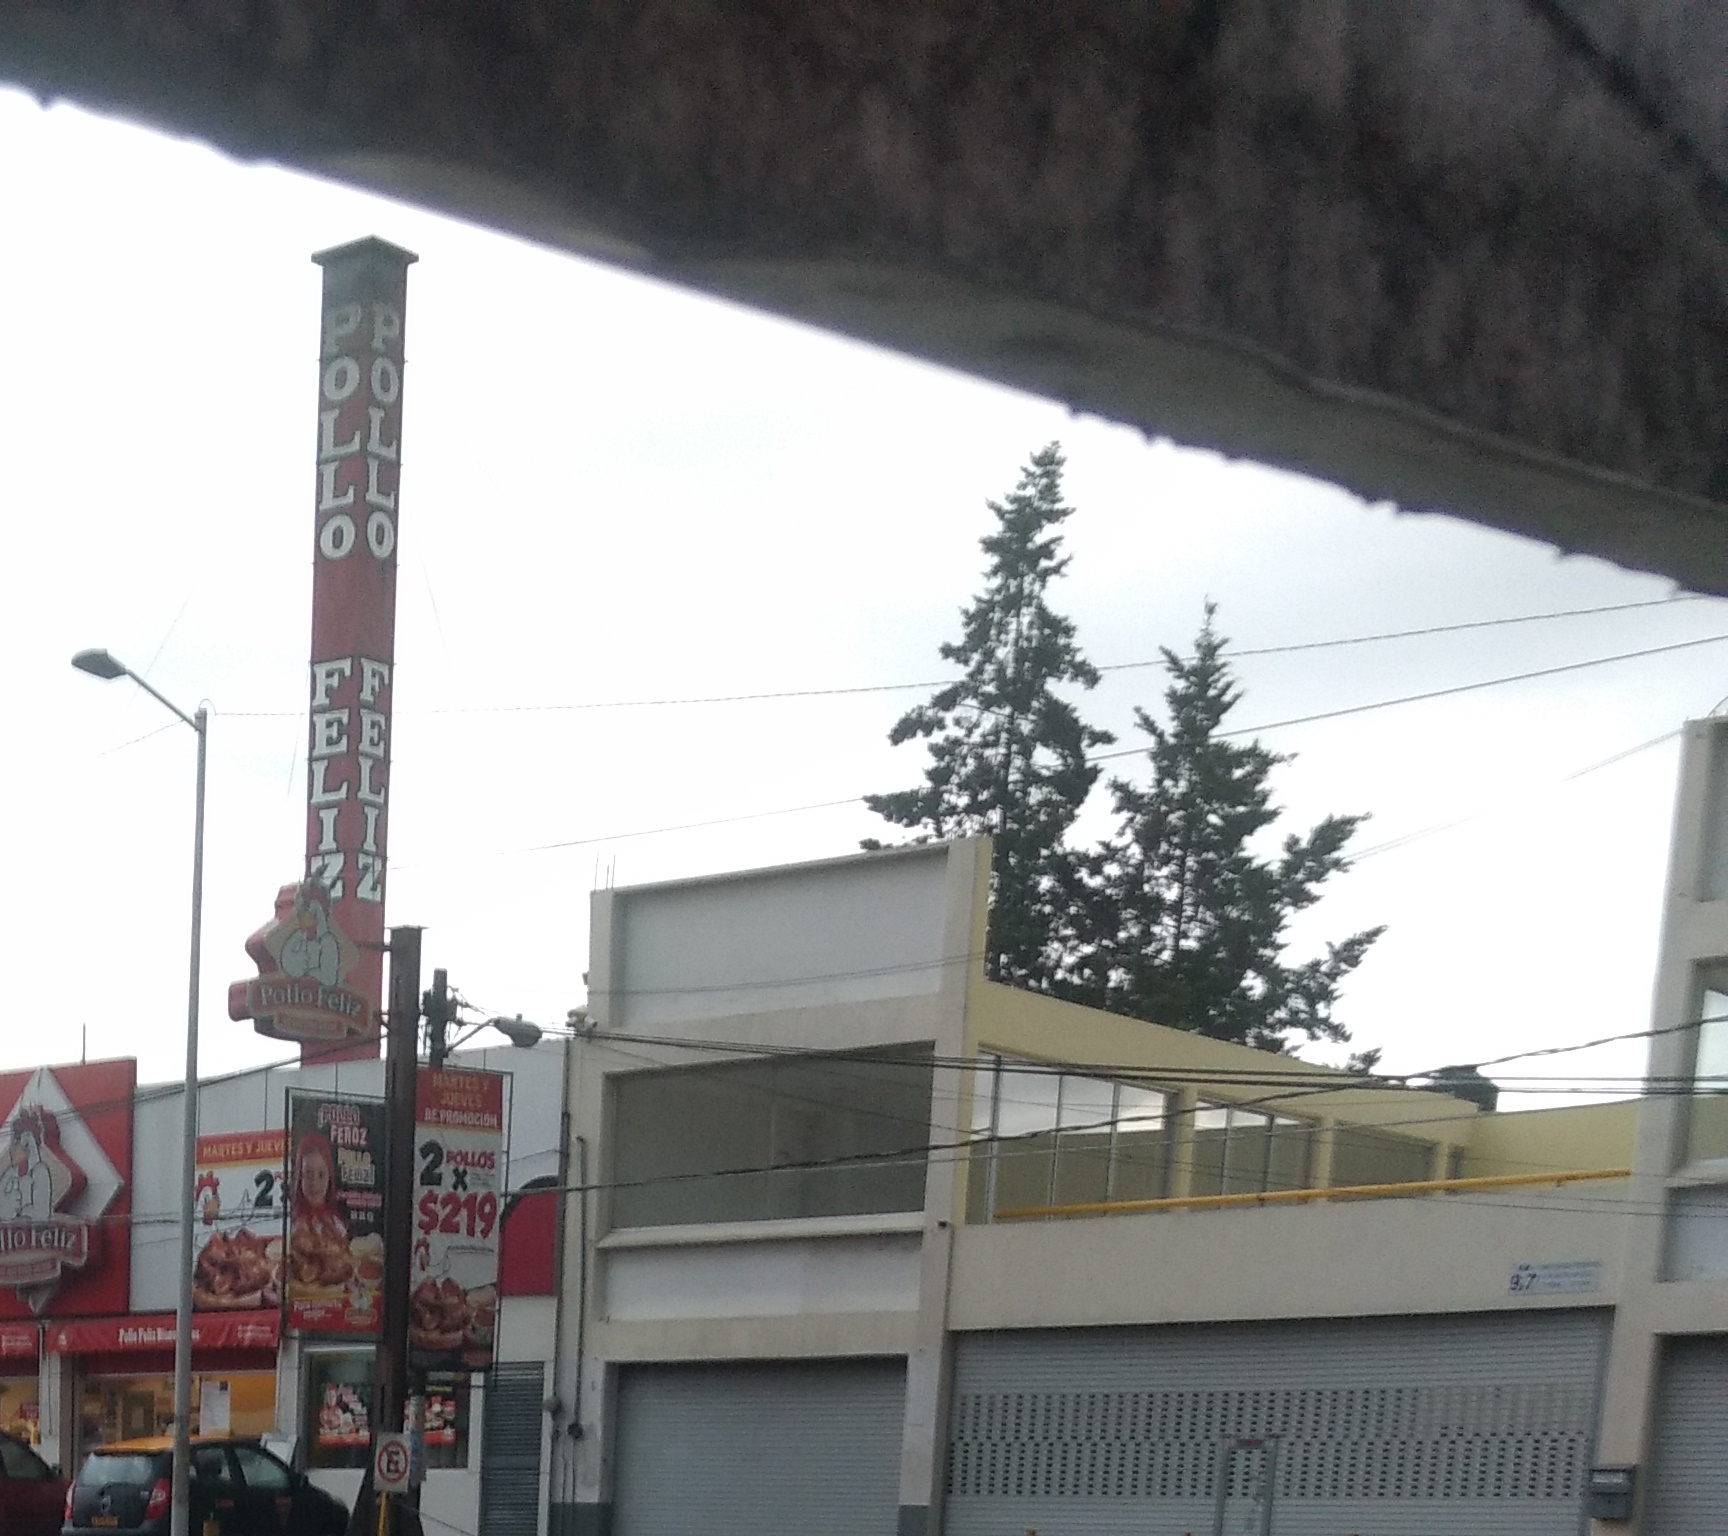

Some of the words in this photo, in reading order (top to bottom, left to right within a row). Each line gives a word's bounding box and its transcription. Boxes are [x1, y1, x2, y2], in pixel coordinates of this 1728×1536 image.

[319, 305, 361, 560] POLLO
[365, 304, 400, 559] POLLO
[309, 659, 352, 898] FELIZ
[356, 660, 391, 901] FELIZ
[259, 983, 312, 1007] Pollo
[330, 1125, 368, 1145] FEROZ
[424, 1107, 438, 1121] DE
[203, 1143, 243, 1158] MARTES
[419, 1139, 444, 1186] 2
[446, 1150, 495, 1170] POLLOS
[254, 1169, 275, 1207] 2
[418, 1188, 497, 1239] $219
